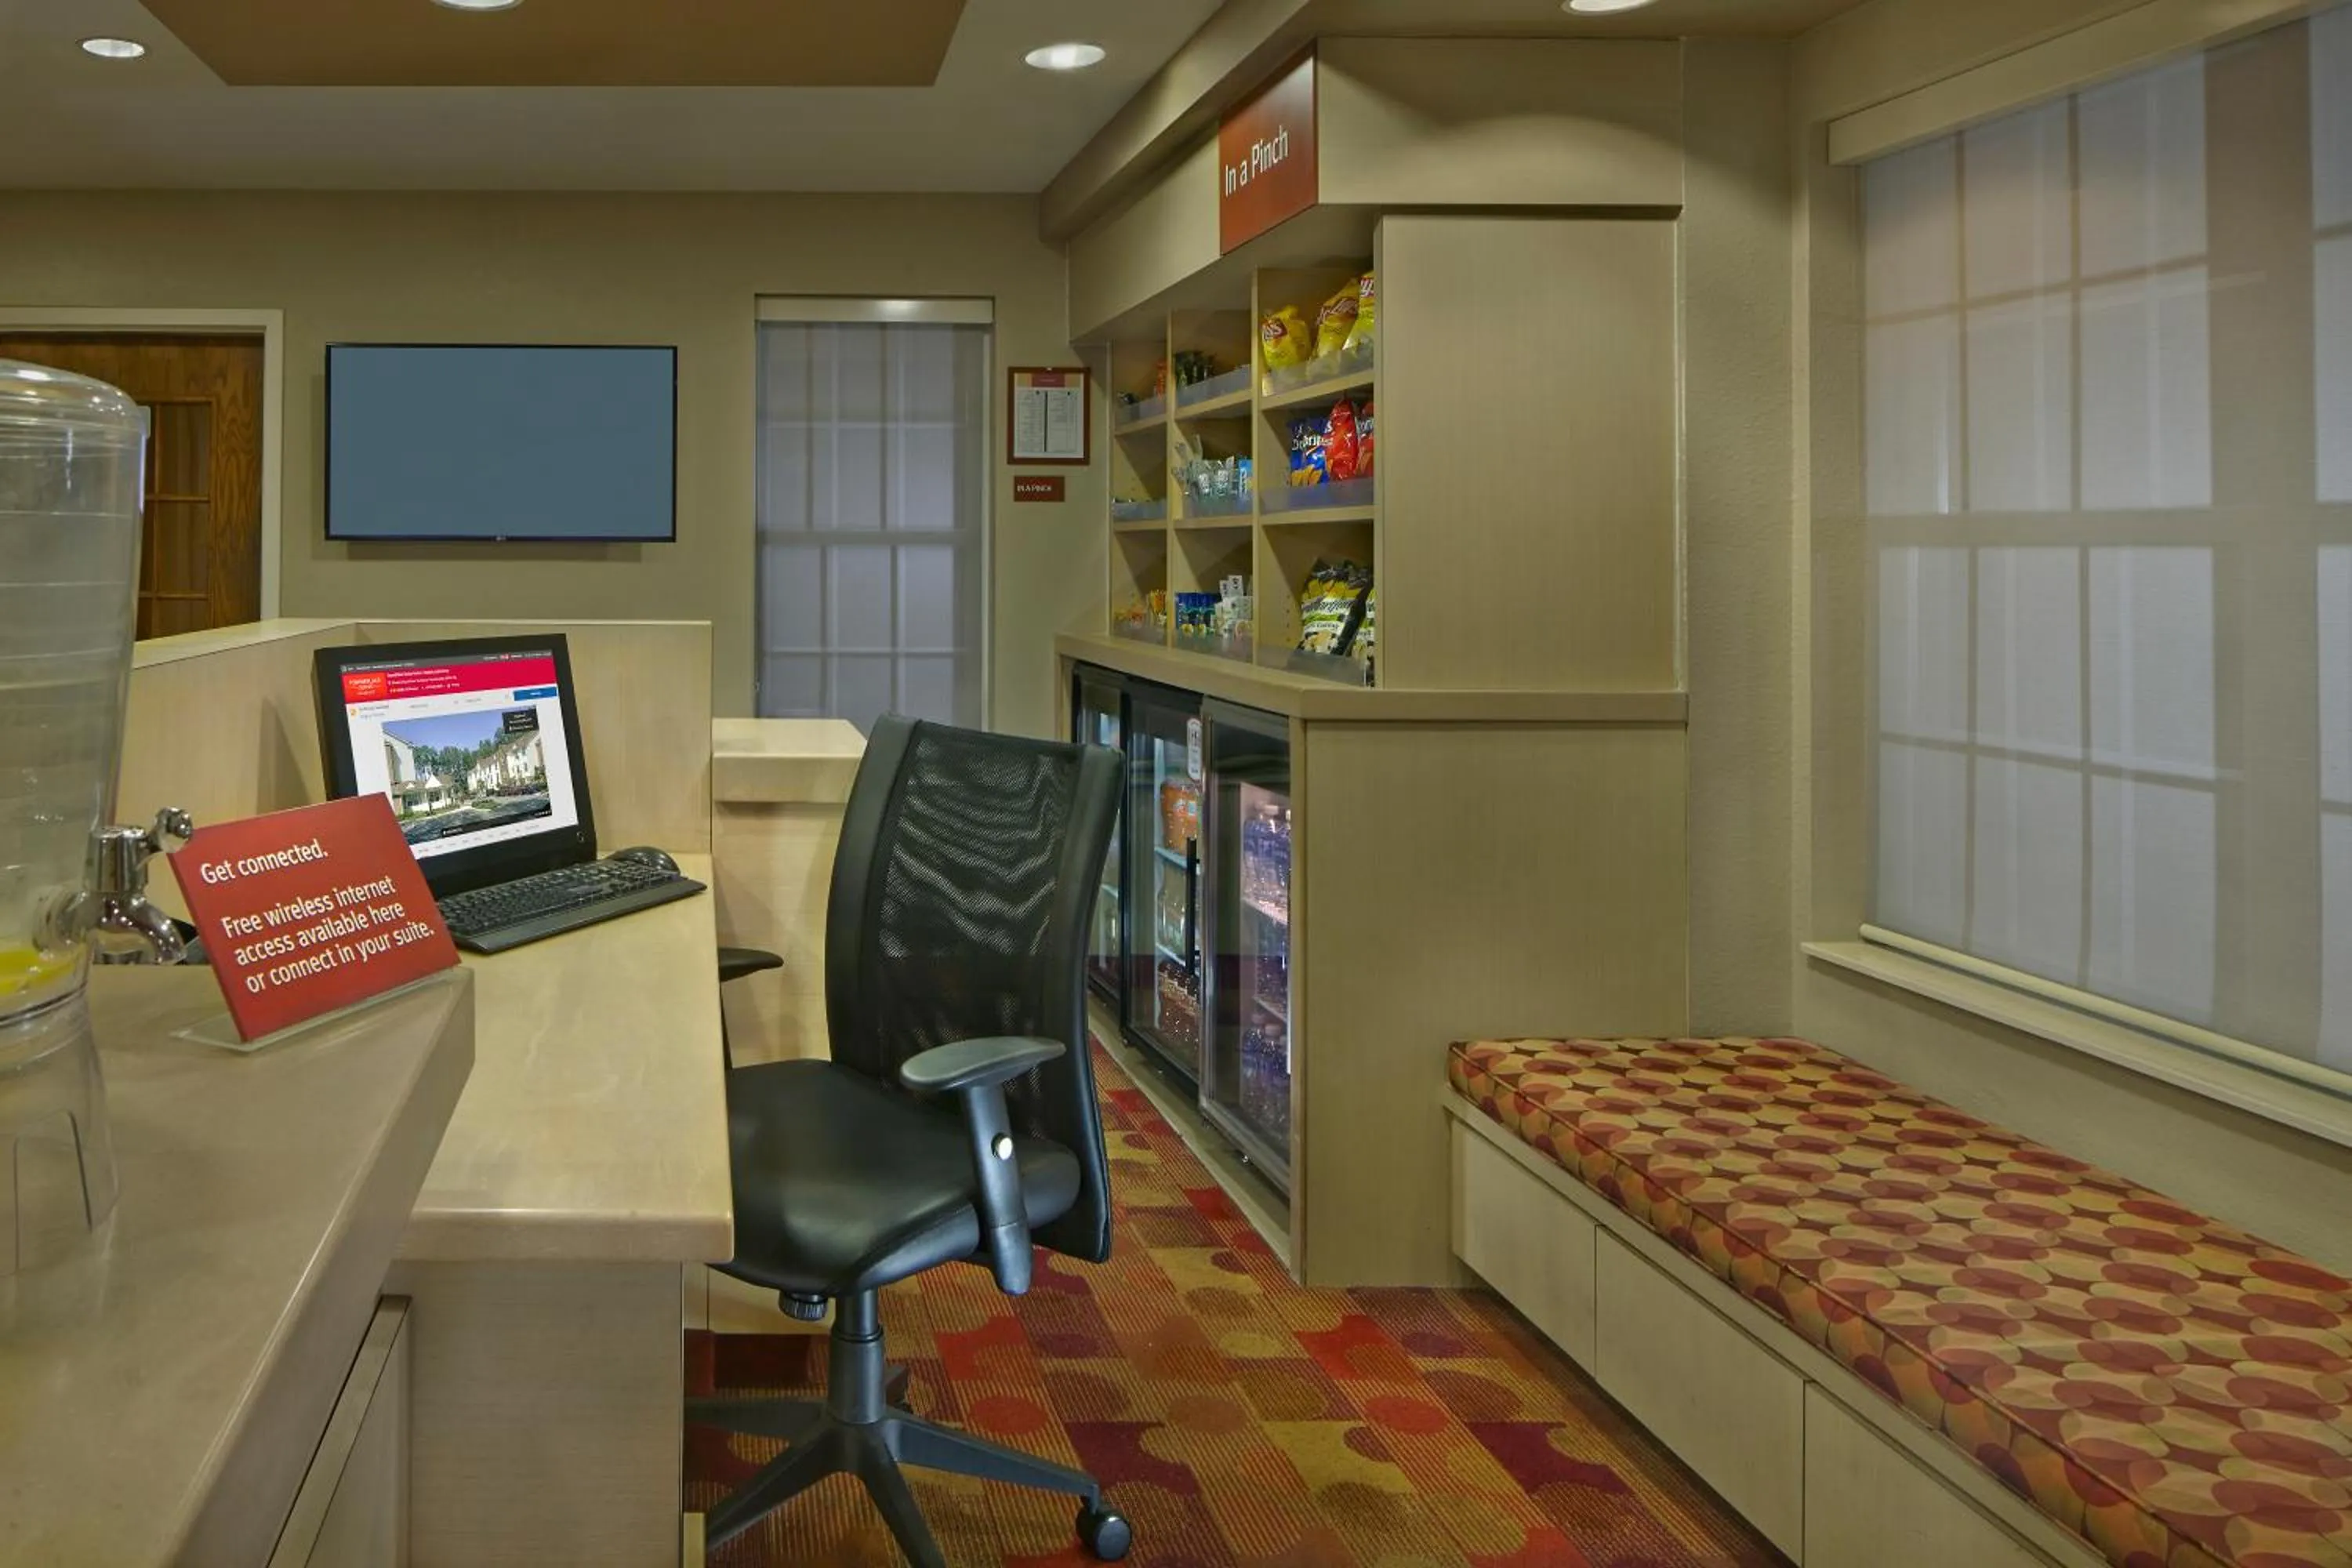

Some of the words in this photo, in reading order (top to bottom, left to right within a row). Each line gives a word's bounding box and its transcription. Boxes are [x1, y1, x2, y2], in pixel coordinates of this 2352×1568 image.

[1225, 164, 1236, 198] In
[1240, 160, 1248, 187] a
[1252, 125, 1288, 179] Pinch
[200, 860, 236, 885] Get
[237, 838, 328, 875] connected.
[220, 915, 263, 939] Free
[264, 894, 334, 928] wireless
[332, 875, 397, 908] internet
[234, 935, 295, 967] access
[297, 912, 370, 948] available
[368, 902, 406, 926] here
[245, 972, 267, 993] or
[269, 949, 337, 985] connect
[335, 943, 355, 964] in
[355, 935, 392, 963] your
[394, 920, 435, 946] suite.
